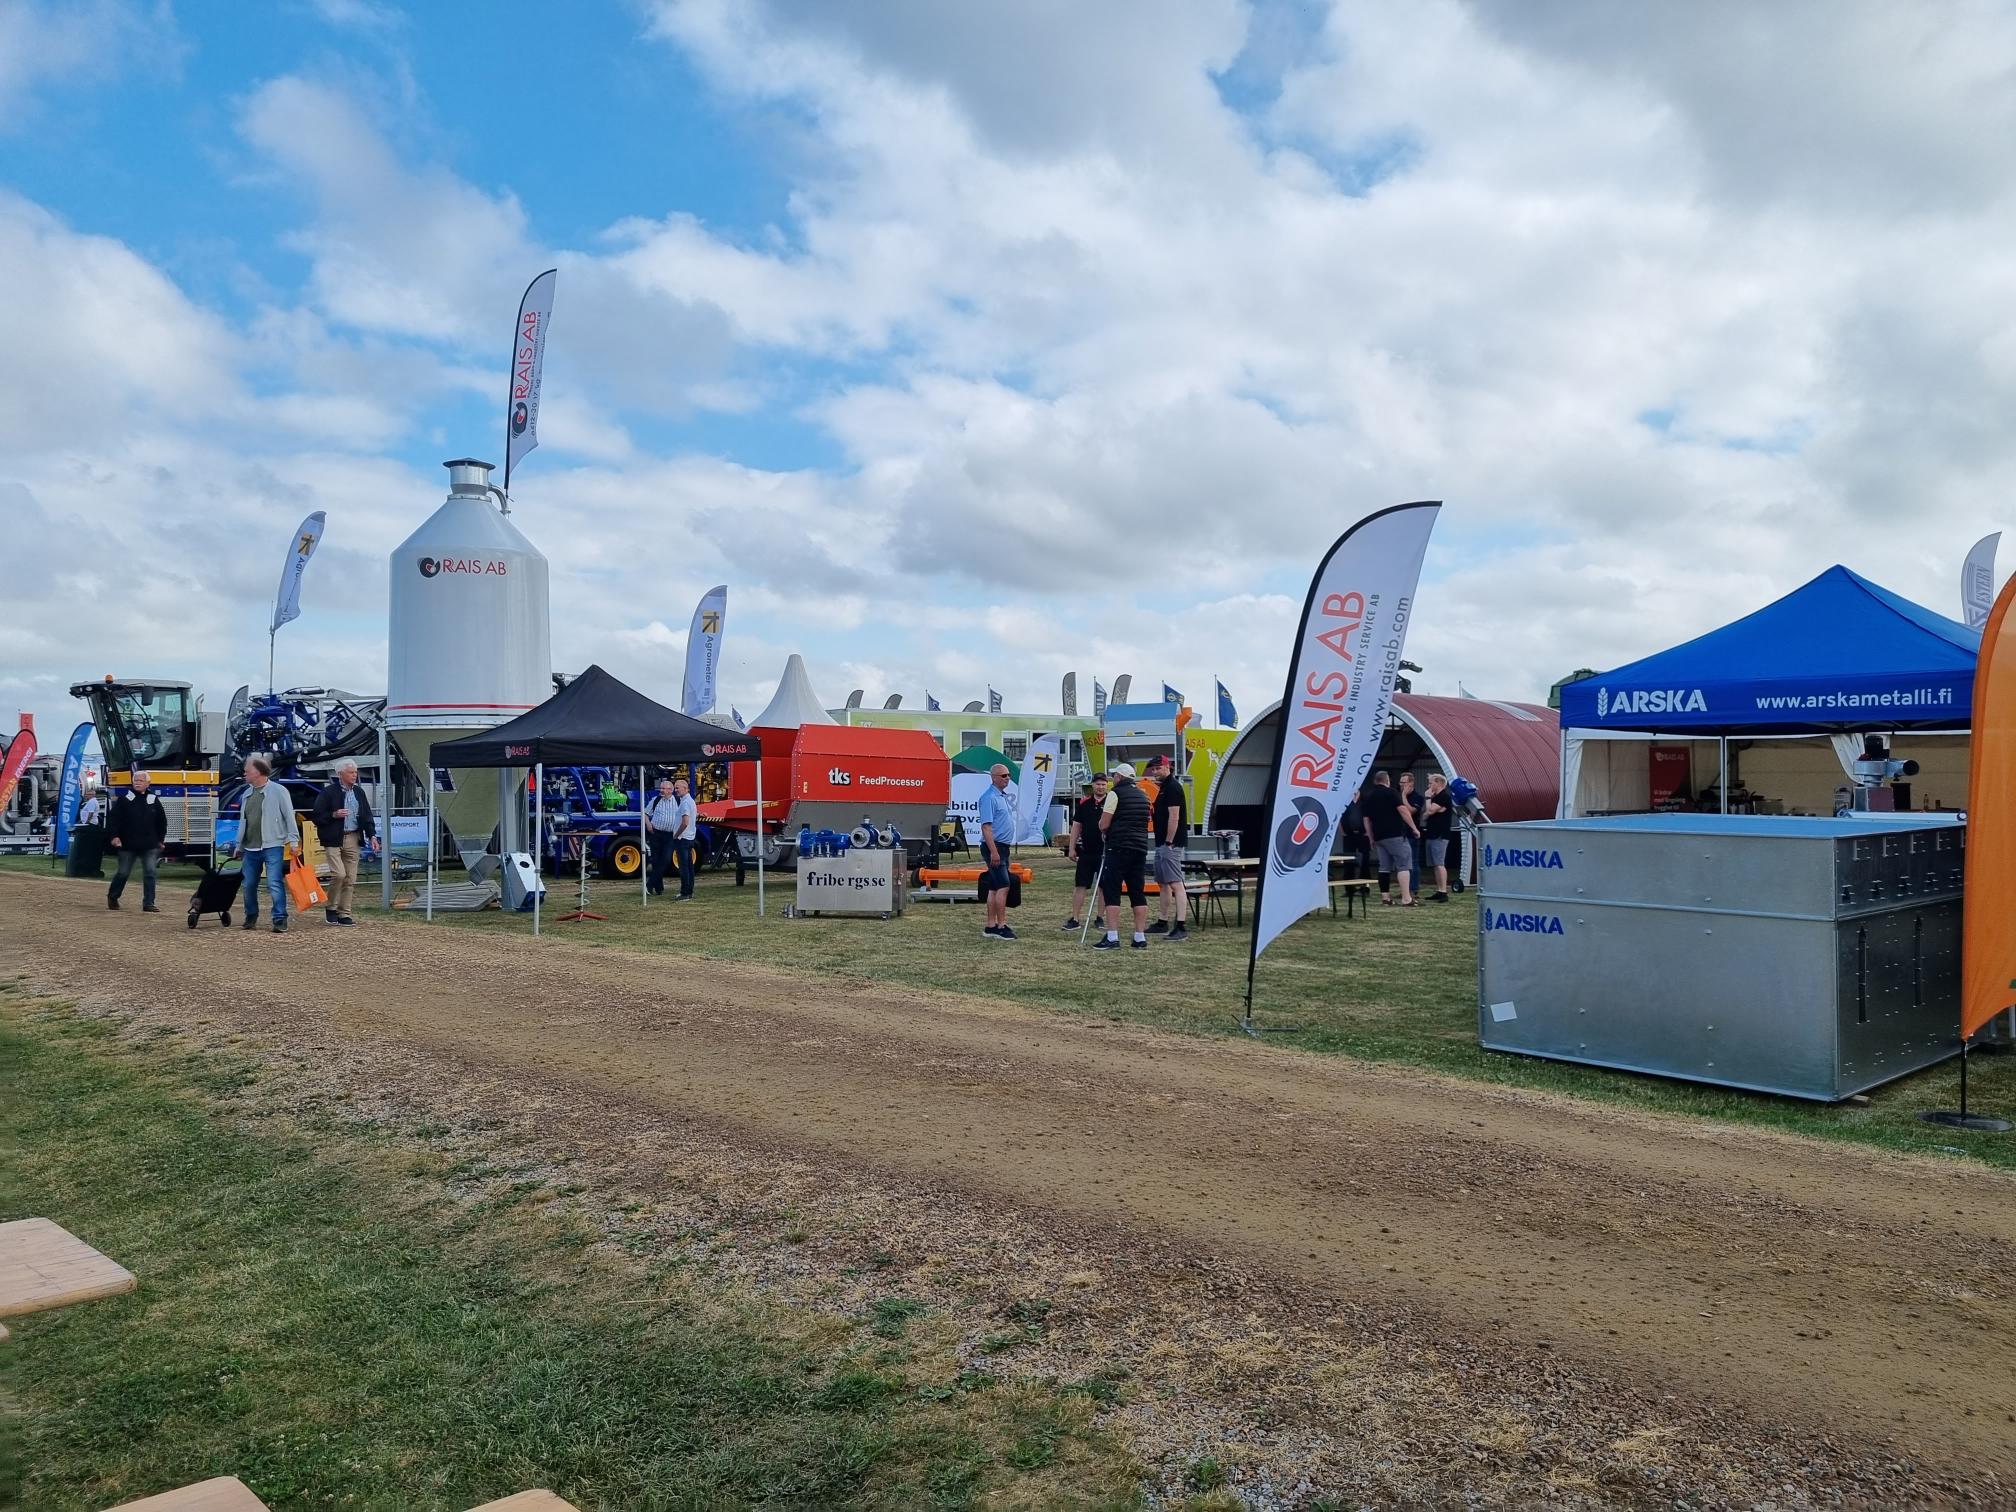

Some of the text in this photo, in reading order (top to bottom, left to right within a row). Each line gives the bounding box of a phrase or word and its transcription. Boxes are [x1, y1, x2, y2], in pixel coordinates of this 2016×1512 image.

[522, 311, 537, 342] AB
[514, 346, 534, 400] RAIS
[442, 559, 507, 576] RAIS AB
[1315, 591, 1365, 663] AB
[705, 635, 715, 685] Agrometer
[1369, 597, 1409, 743] www.raisab.com
[1331, 747, 1349, 792] RONGERS
[1341, 715, 1354, 743] AGRO
[1351, 653, 1367, 702] INDUSTRY
[1359, 608, 1377, 650] SERVICE
[1368, 593, 1380, 607] AB
[1609, 688, 1952, 714] ARSKA www.arskametalli.fi
[715, 744, 747, 754] RAIS AB
[1286, 671, 1349, 791] RAIS
[62, 754, 79, 825] AdBlue
[828, 767, 925, 787] tks FeedProcessor
[1494, 849, 1564, 870] ARSKA
[1495, 912, 1565, 935] ARSKA
